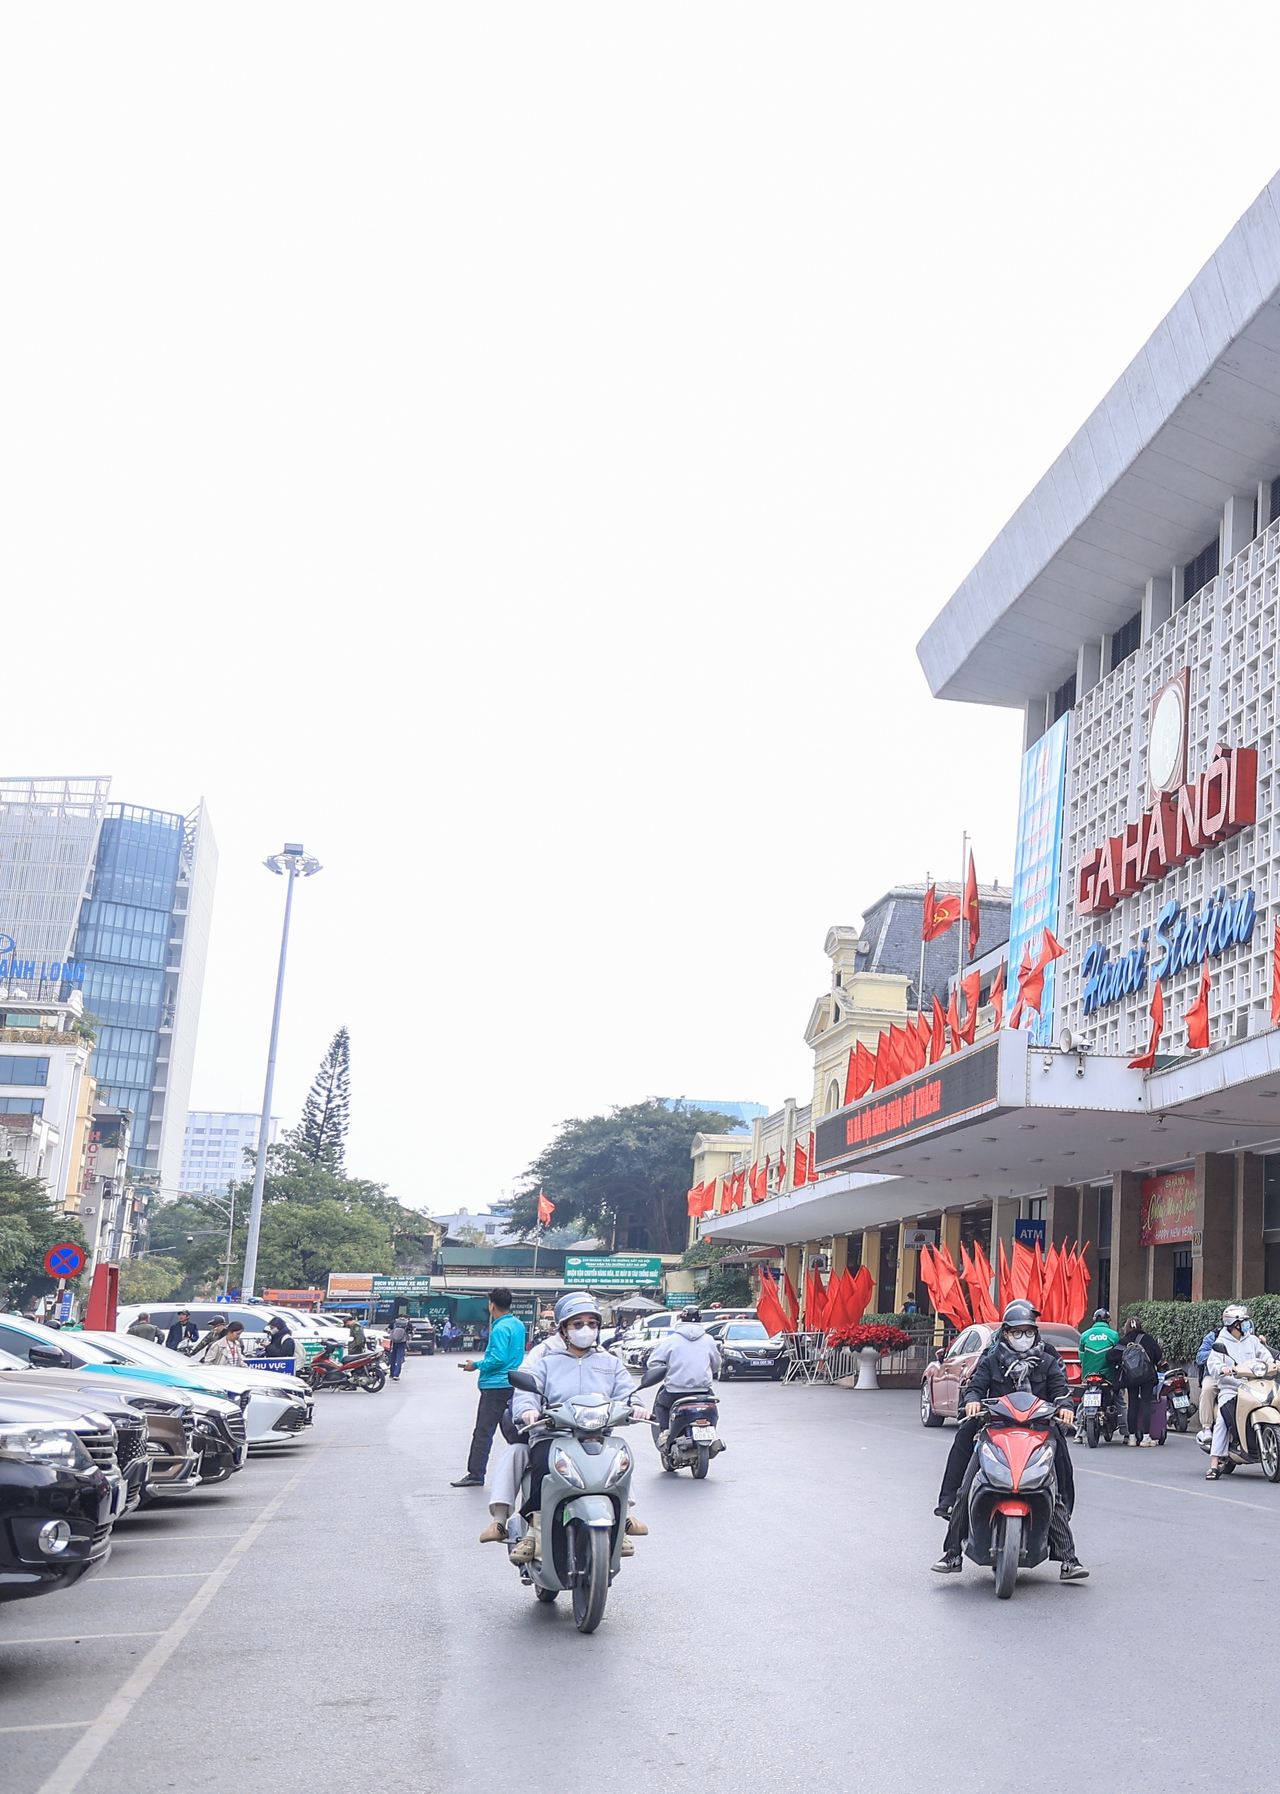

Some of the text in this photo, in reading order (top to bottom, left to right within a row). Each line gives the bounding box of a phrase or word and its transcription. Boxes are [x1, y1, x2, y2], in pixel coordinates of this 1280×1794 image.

[1076, 743, 1257, 917] GA HÀ NỘI
[1082, 886, 1257, 1016] Hanoi Station
[41, 961, 86, 982] LONG
[83, 1131, 101, 1190] HOTEL
[1020, 1229, 1043, 1239] ATM
[1155, 1225, 1193, 1240] HAPPY NEW YEAR
[429, 1307, 446, 1315] 24/7
[1089, 1333, 1108, 1341] Grab
[268, 1362, 286, 1371] VỰC
